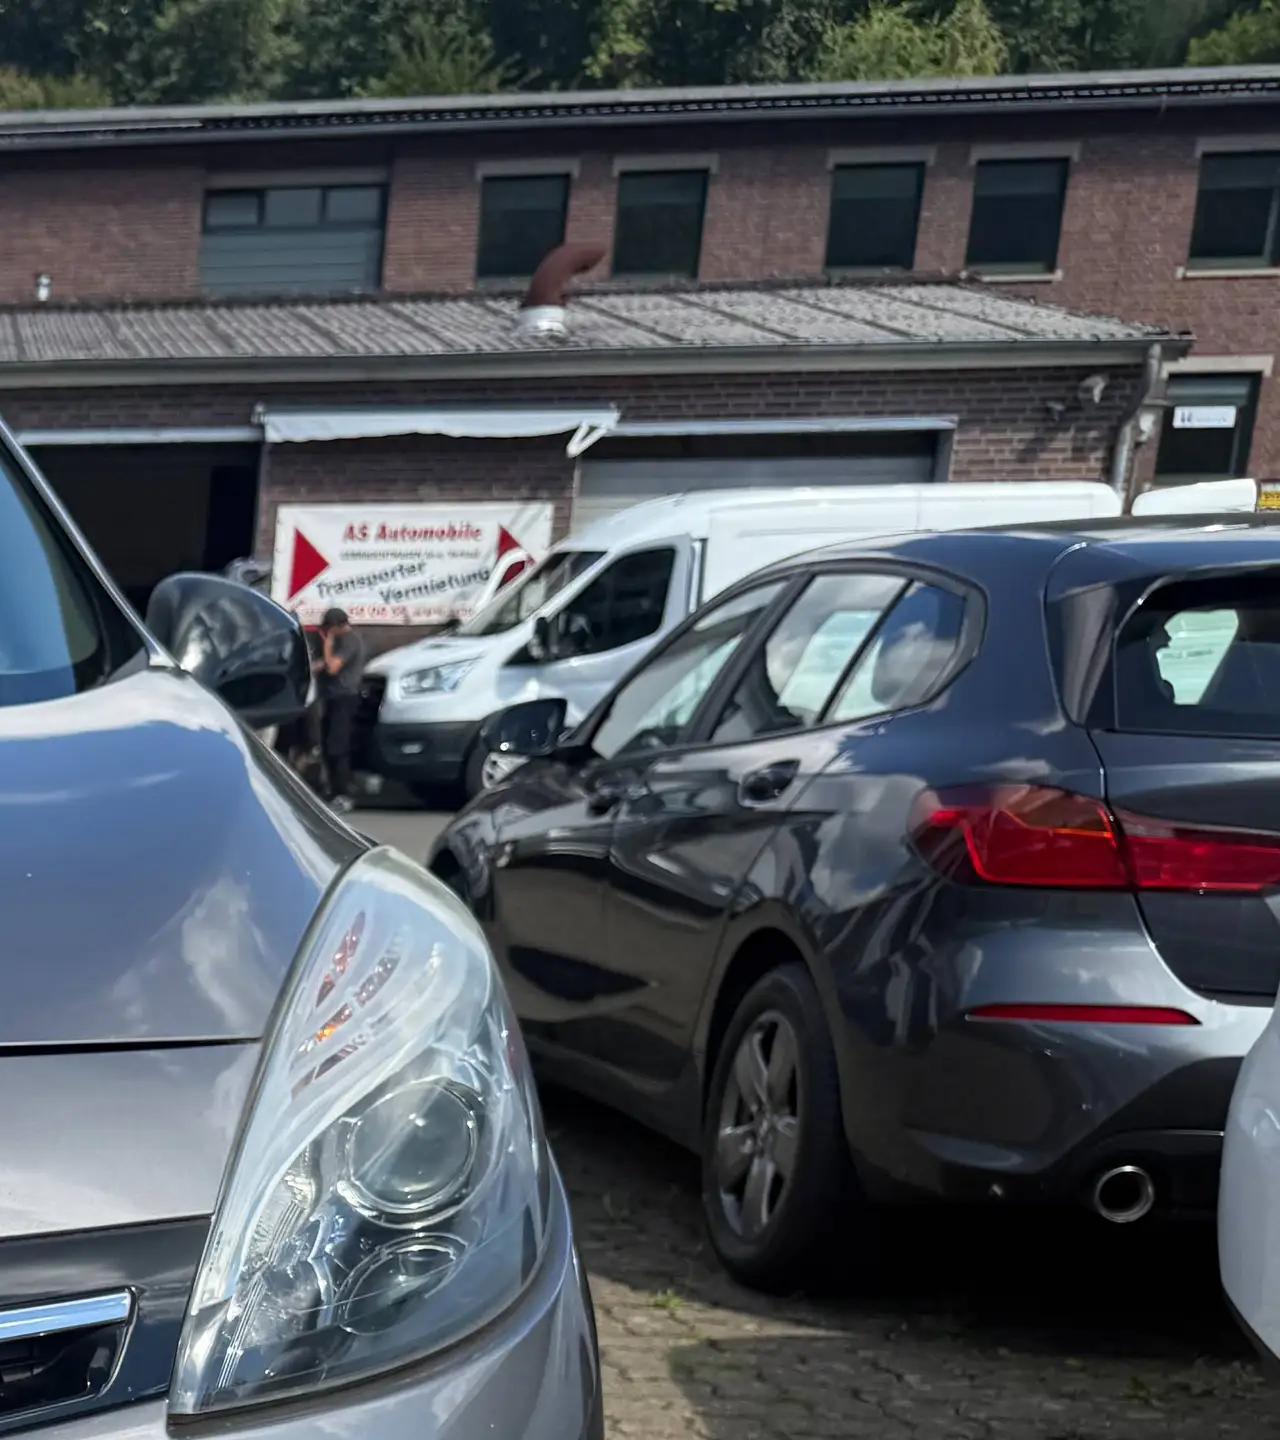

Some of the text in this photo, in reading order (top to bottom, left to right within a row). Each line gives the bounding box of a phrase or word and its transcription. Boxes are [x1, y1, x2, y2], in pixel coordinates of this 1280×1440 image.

[343, 520, 482, 542] AS Automobile
[316, 560, 428, 600] Transporter
